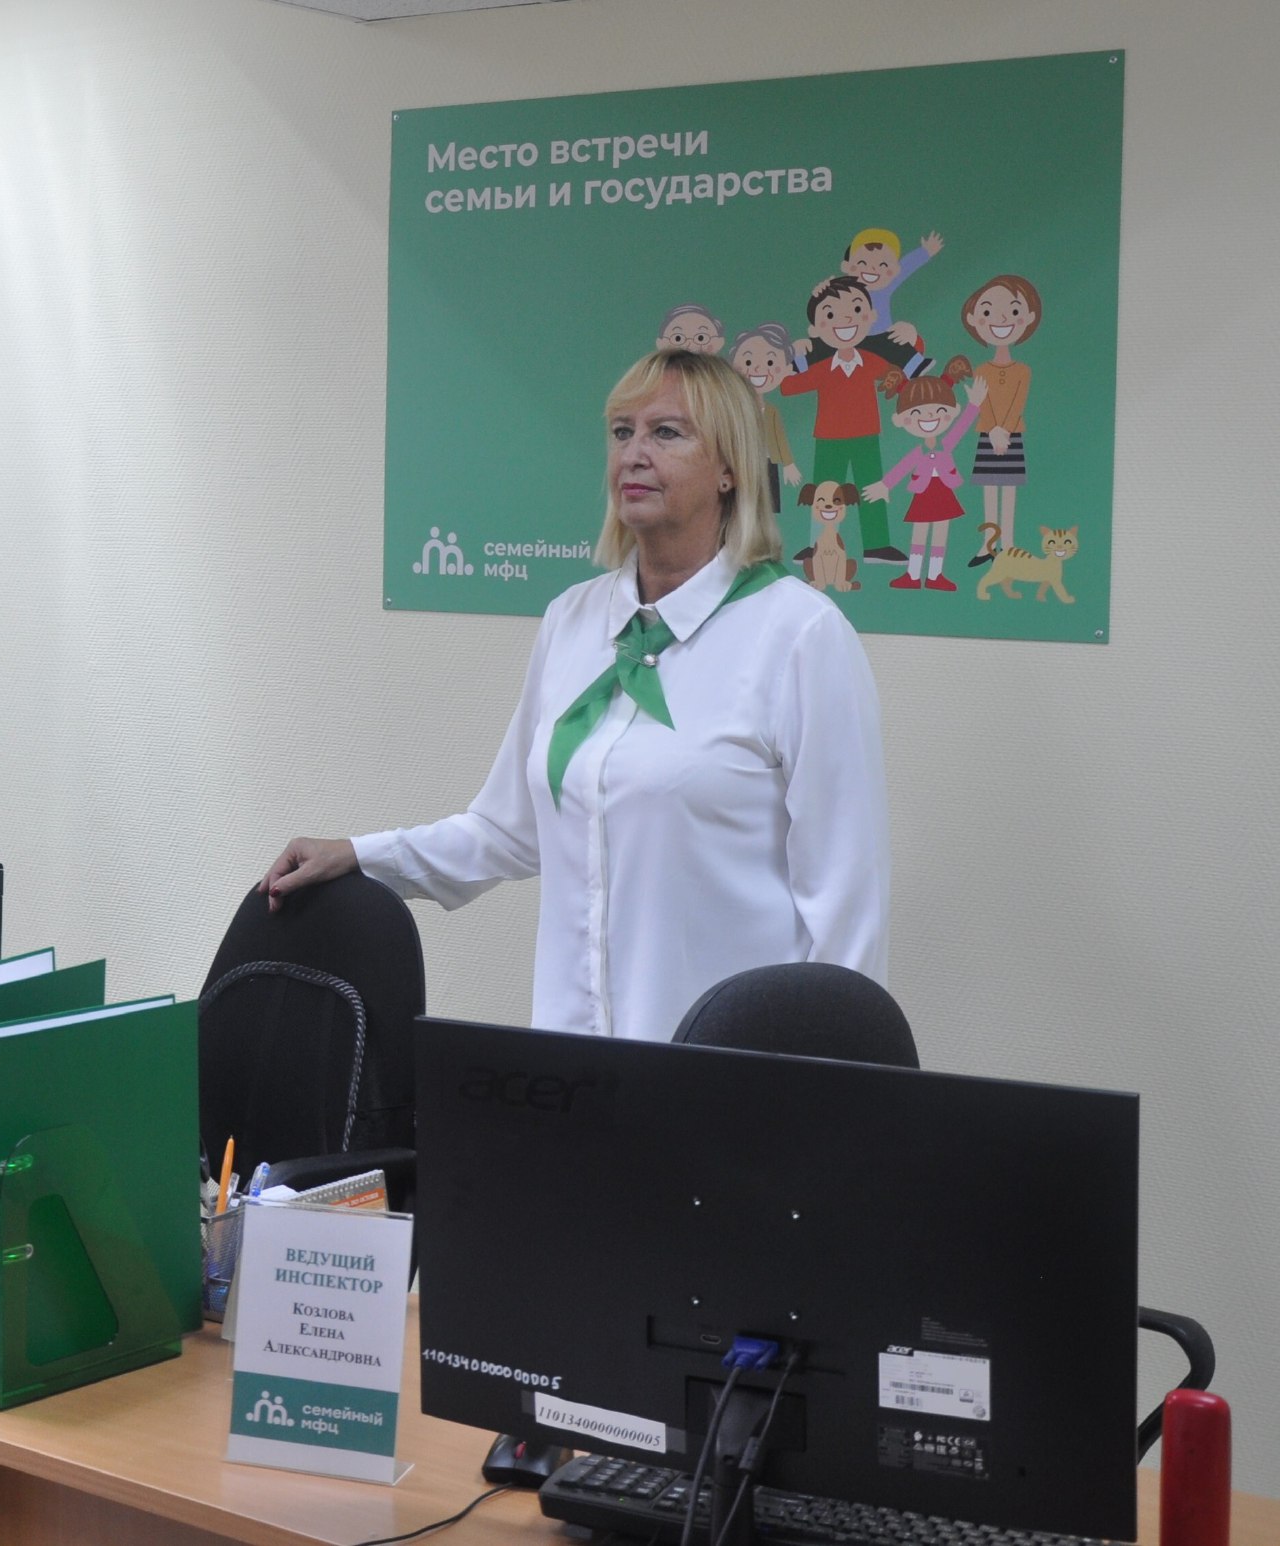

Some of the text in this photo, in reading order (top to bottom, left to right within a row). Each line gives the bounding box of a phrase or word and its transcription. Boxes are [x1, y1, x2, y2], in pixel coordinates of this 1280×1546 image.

[427, 130, 708, 173] Место встречи
[425, 166, 833, 214] семьи и государства
[484, 539, 591, 559] семейный
[484, 560, 528, 581] мфц
[286, 1248, 375, 1271] ВЕДУЩИЙ
[274, 1268, 383, 1294] ИНСПЕКТОР
[886, 1345, 913, 1355] acer
[302, 1404, 383, 1426] семейный
[301, 1418, 339, 1436] мфц
